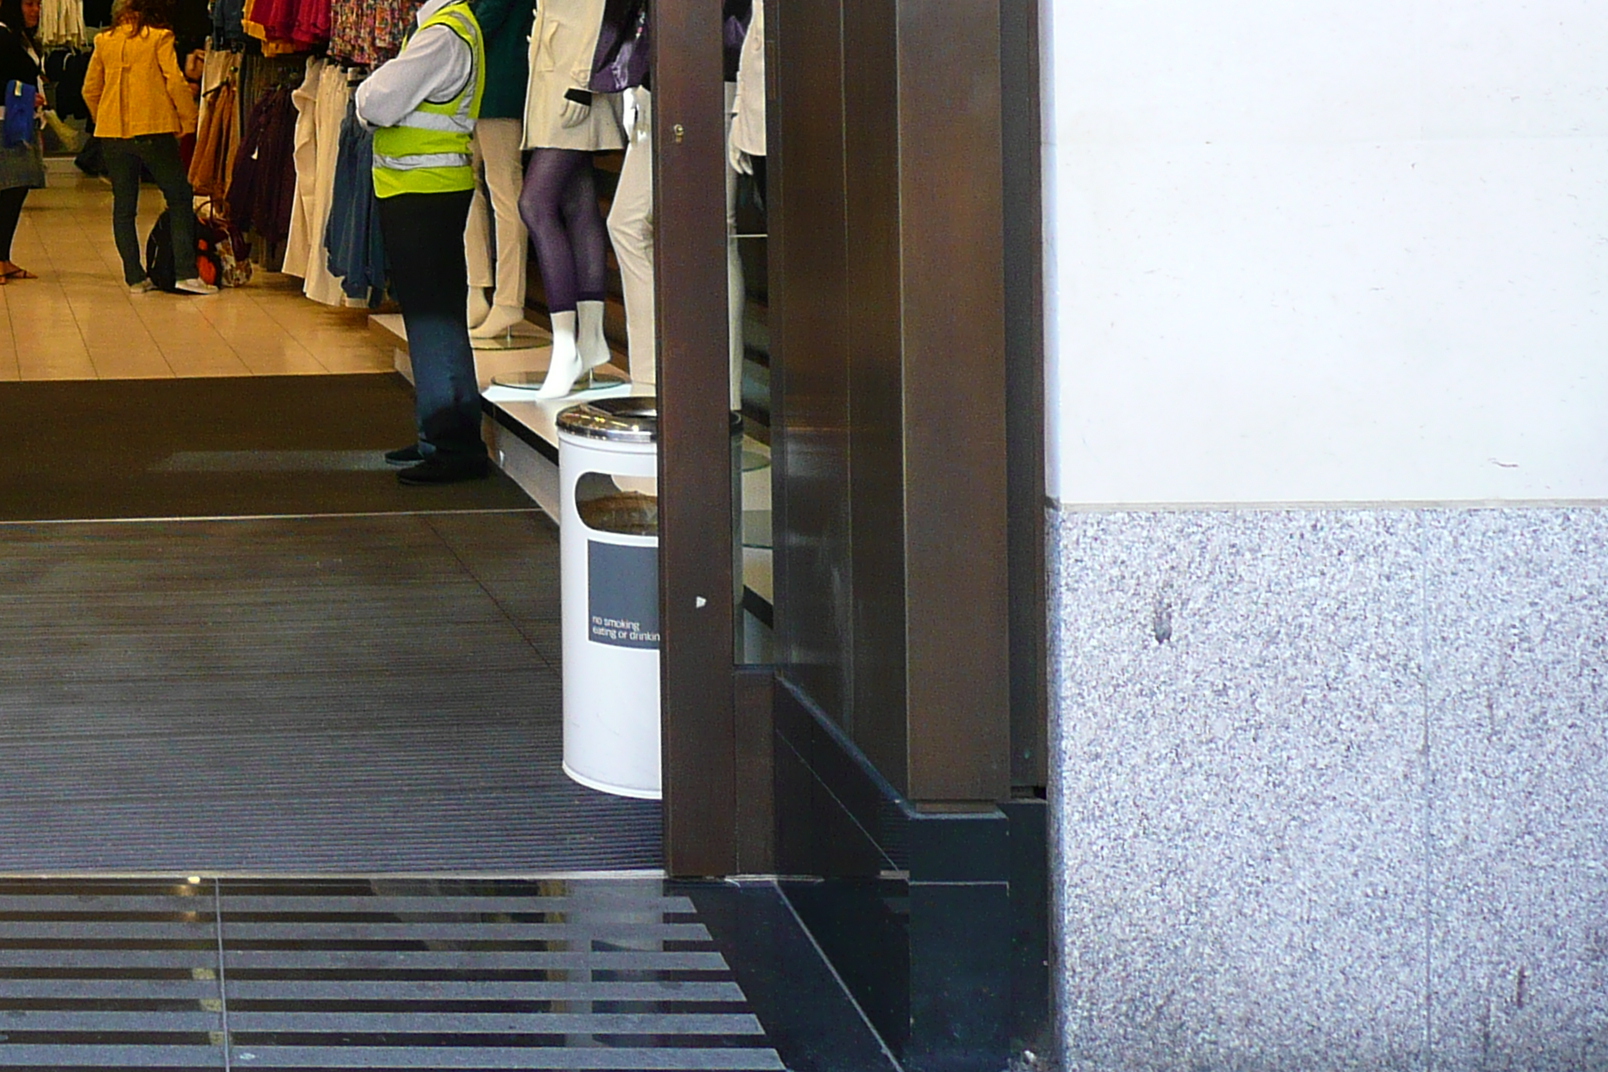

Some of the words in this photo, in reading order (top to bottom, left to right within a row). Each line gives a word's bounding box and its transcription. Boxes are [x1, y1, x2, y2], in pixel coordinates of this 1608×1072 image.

[592, 615, 602, 625] no
[604, 618, 640, 632] smoking
[592, 626, 617, 640] eating
[618, 630, 628, 639] or
[629, 631, 660, 641] drinkin
